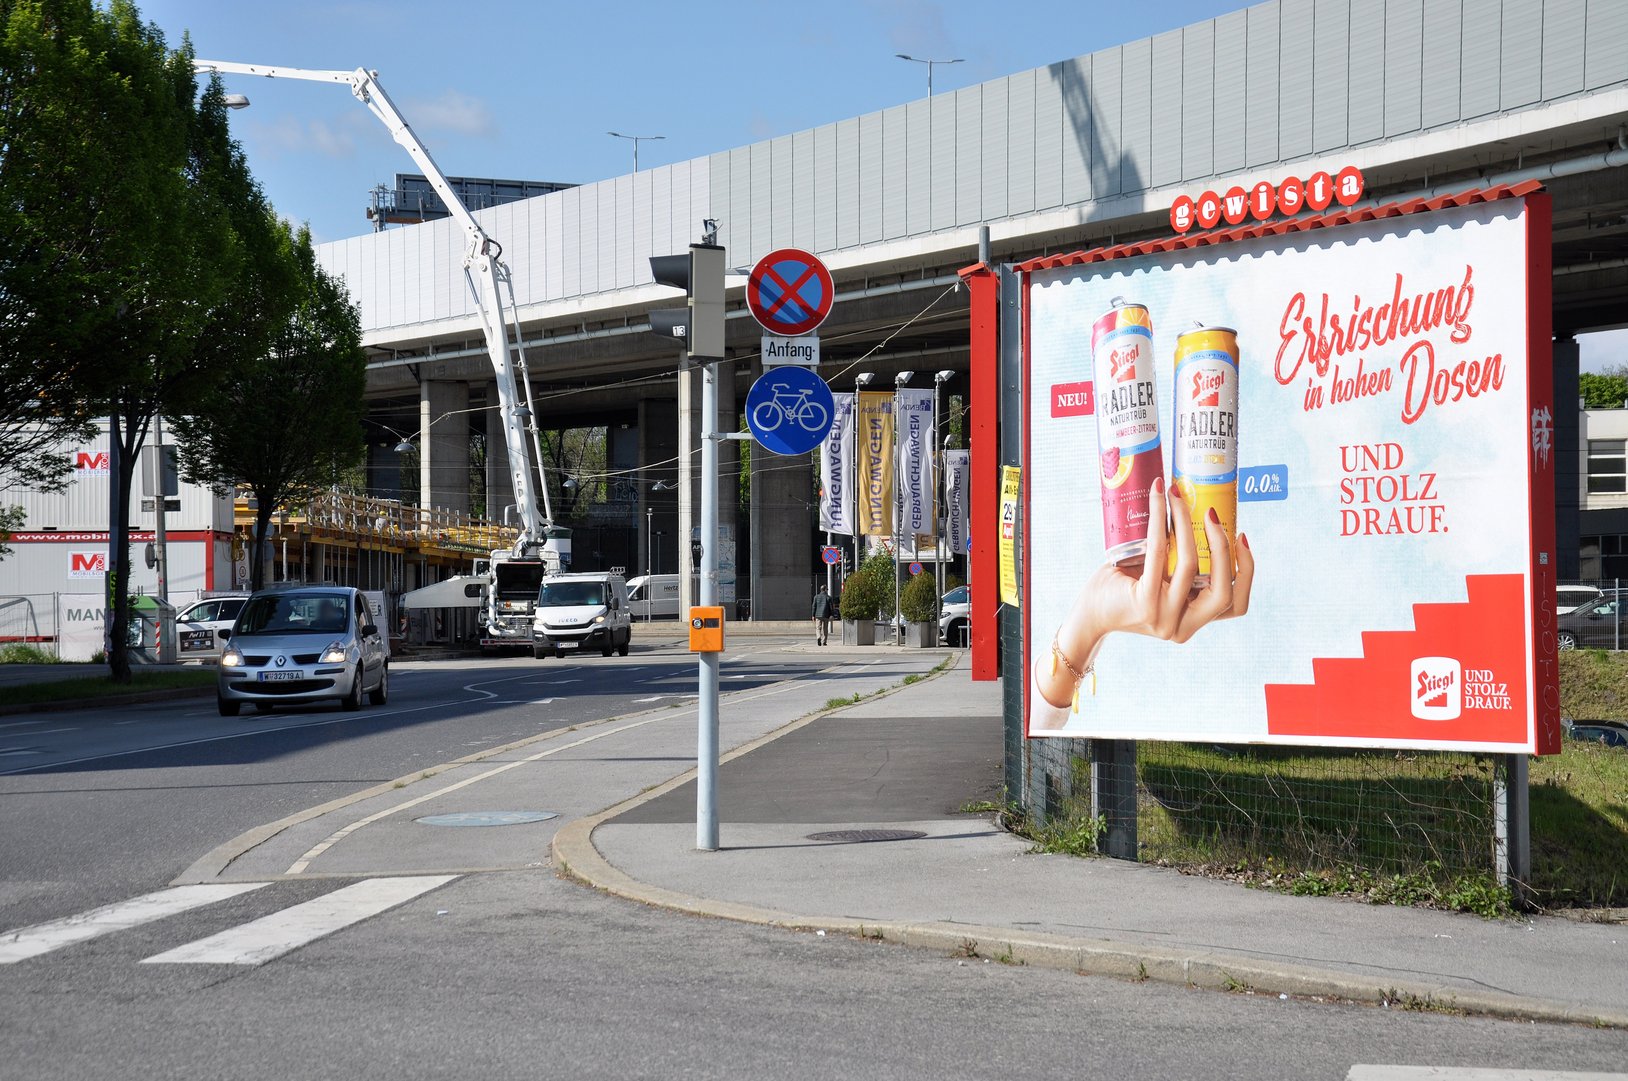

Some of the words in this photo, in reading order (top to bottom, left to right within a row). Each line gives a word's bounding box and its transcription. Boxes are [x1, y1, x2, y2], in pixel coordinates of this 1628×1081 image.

[1175, 174, 1361, 229] gewista
[673, 326, 685, 336] 13
[1274, 264, 1475, 386] Erfrischung
[767, 341, 814, 361] Anfang
[1110, 344, 1140, 379] Stiegl
[1192, 370, 1225, 400] Stiegl
[1303, 377, 1325, 412] in
[1330, 358, 1393, 405] hohen
[1400, 339, 1507, 426] Dosen
[1057, 392, 1088, 408] NEU!
[1101, 381, 1154, 417] RADLER
[1110, 408, 1147, 427] NATURTRÜB
[1180, 411, 1234, 438] RADLER
[1187, 435, 1226, 450] NATURTRÜB
[1339, 442, 1405, 473] UND
[1340, 473, 1439, 504] STOLZ
[1339, 504, 1450, 536] DRAUF.
[1416, 669, 1454, 700] Stiegl
[1464, 669, 1494, 683] UND
[1464, 682, 1508, 696] STOLZ
[1464, 696, 1513, 710] DRAUF.
